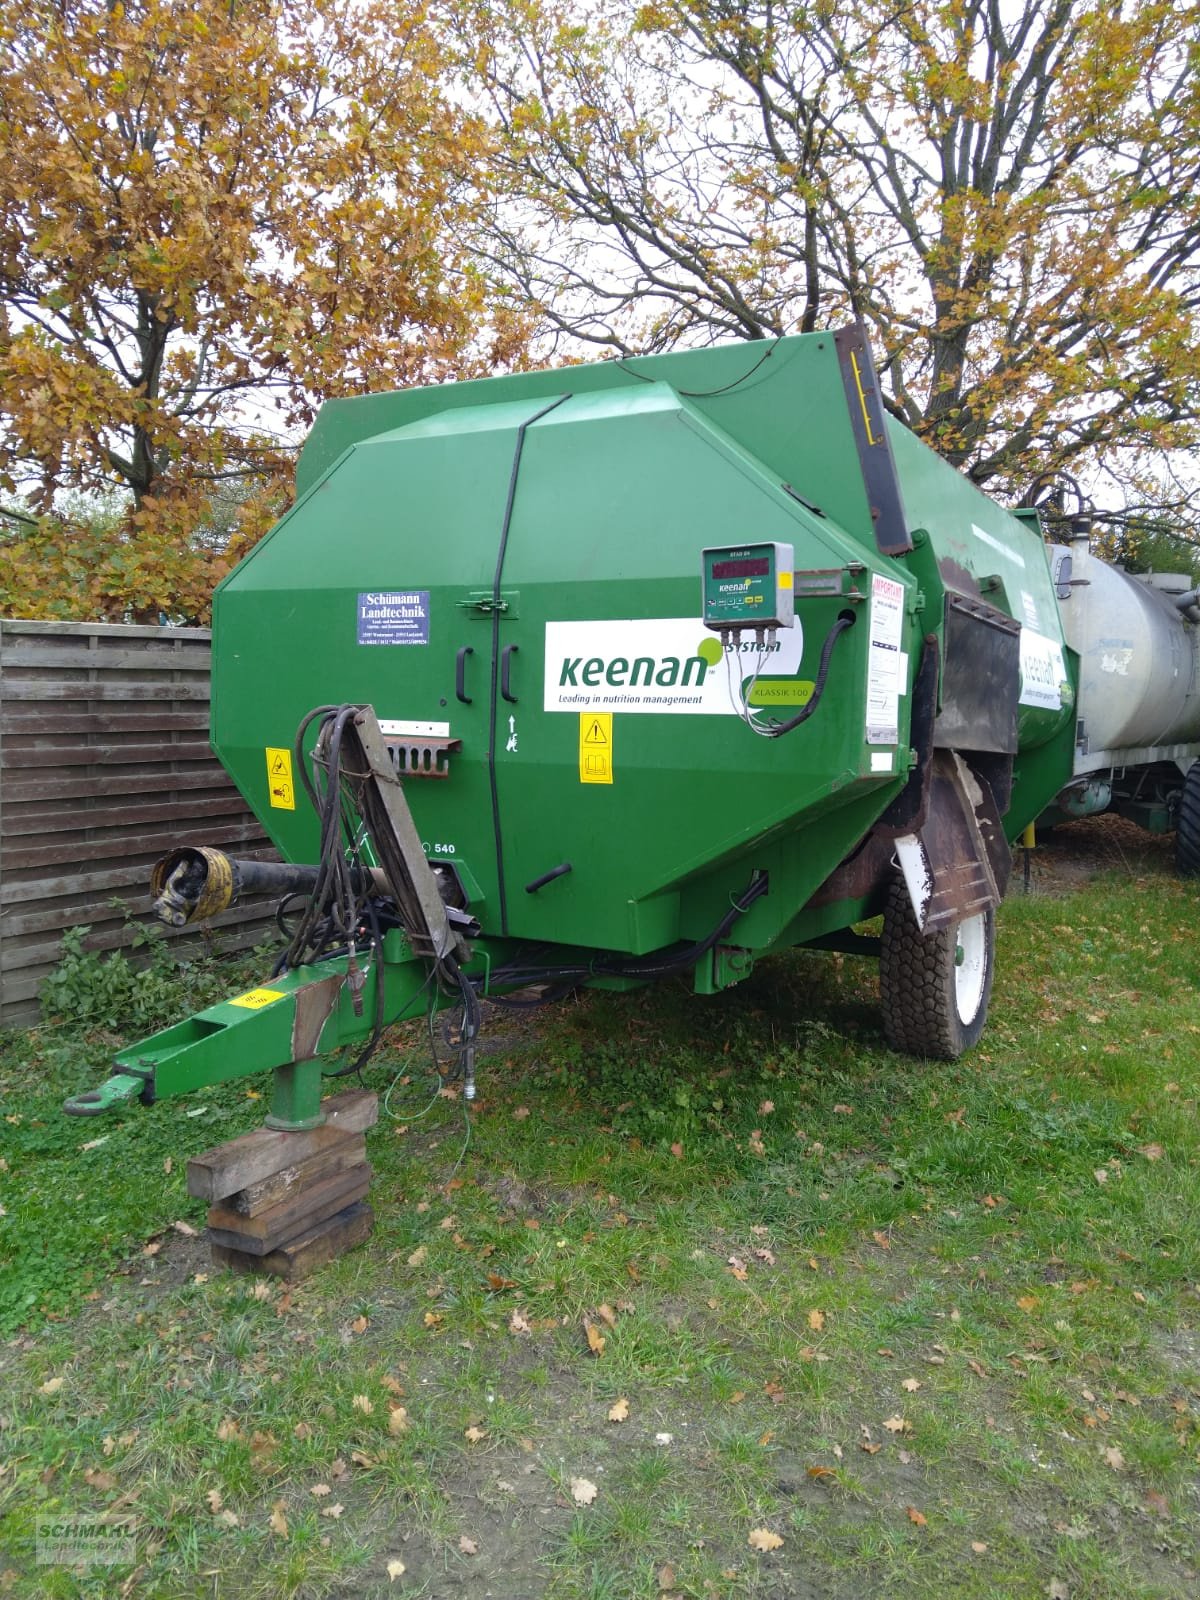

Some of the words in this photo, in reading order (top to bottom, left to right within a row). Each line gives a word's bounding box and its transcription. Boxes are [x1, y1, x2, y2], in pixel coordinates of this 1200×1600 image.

[874, 576, 902, 598] IMPORTANT
[366, 593, 420, 605] Schümann
[361, 605, 426, 618] Landtechnik
[754, 688, 790, 697] KLASSIK
[792, 688, 809, 697] 100
[558, 694, 591, 705] Leading
[592, 694, 601, 703] in
[602, 694, 641, 704] nutrition
[642, 695, 703, 706] management
[434, 843, 456, 854] 540
